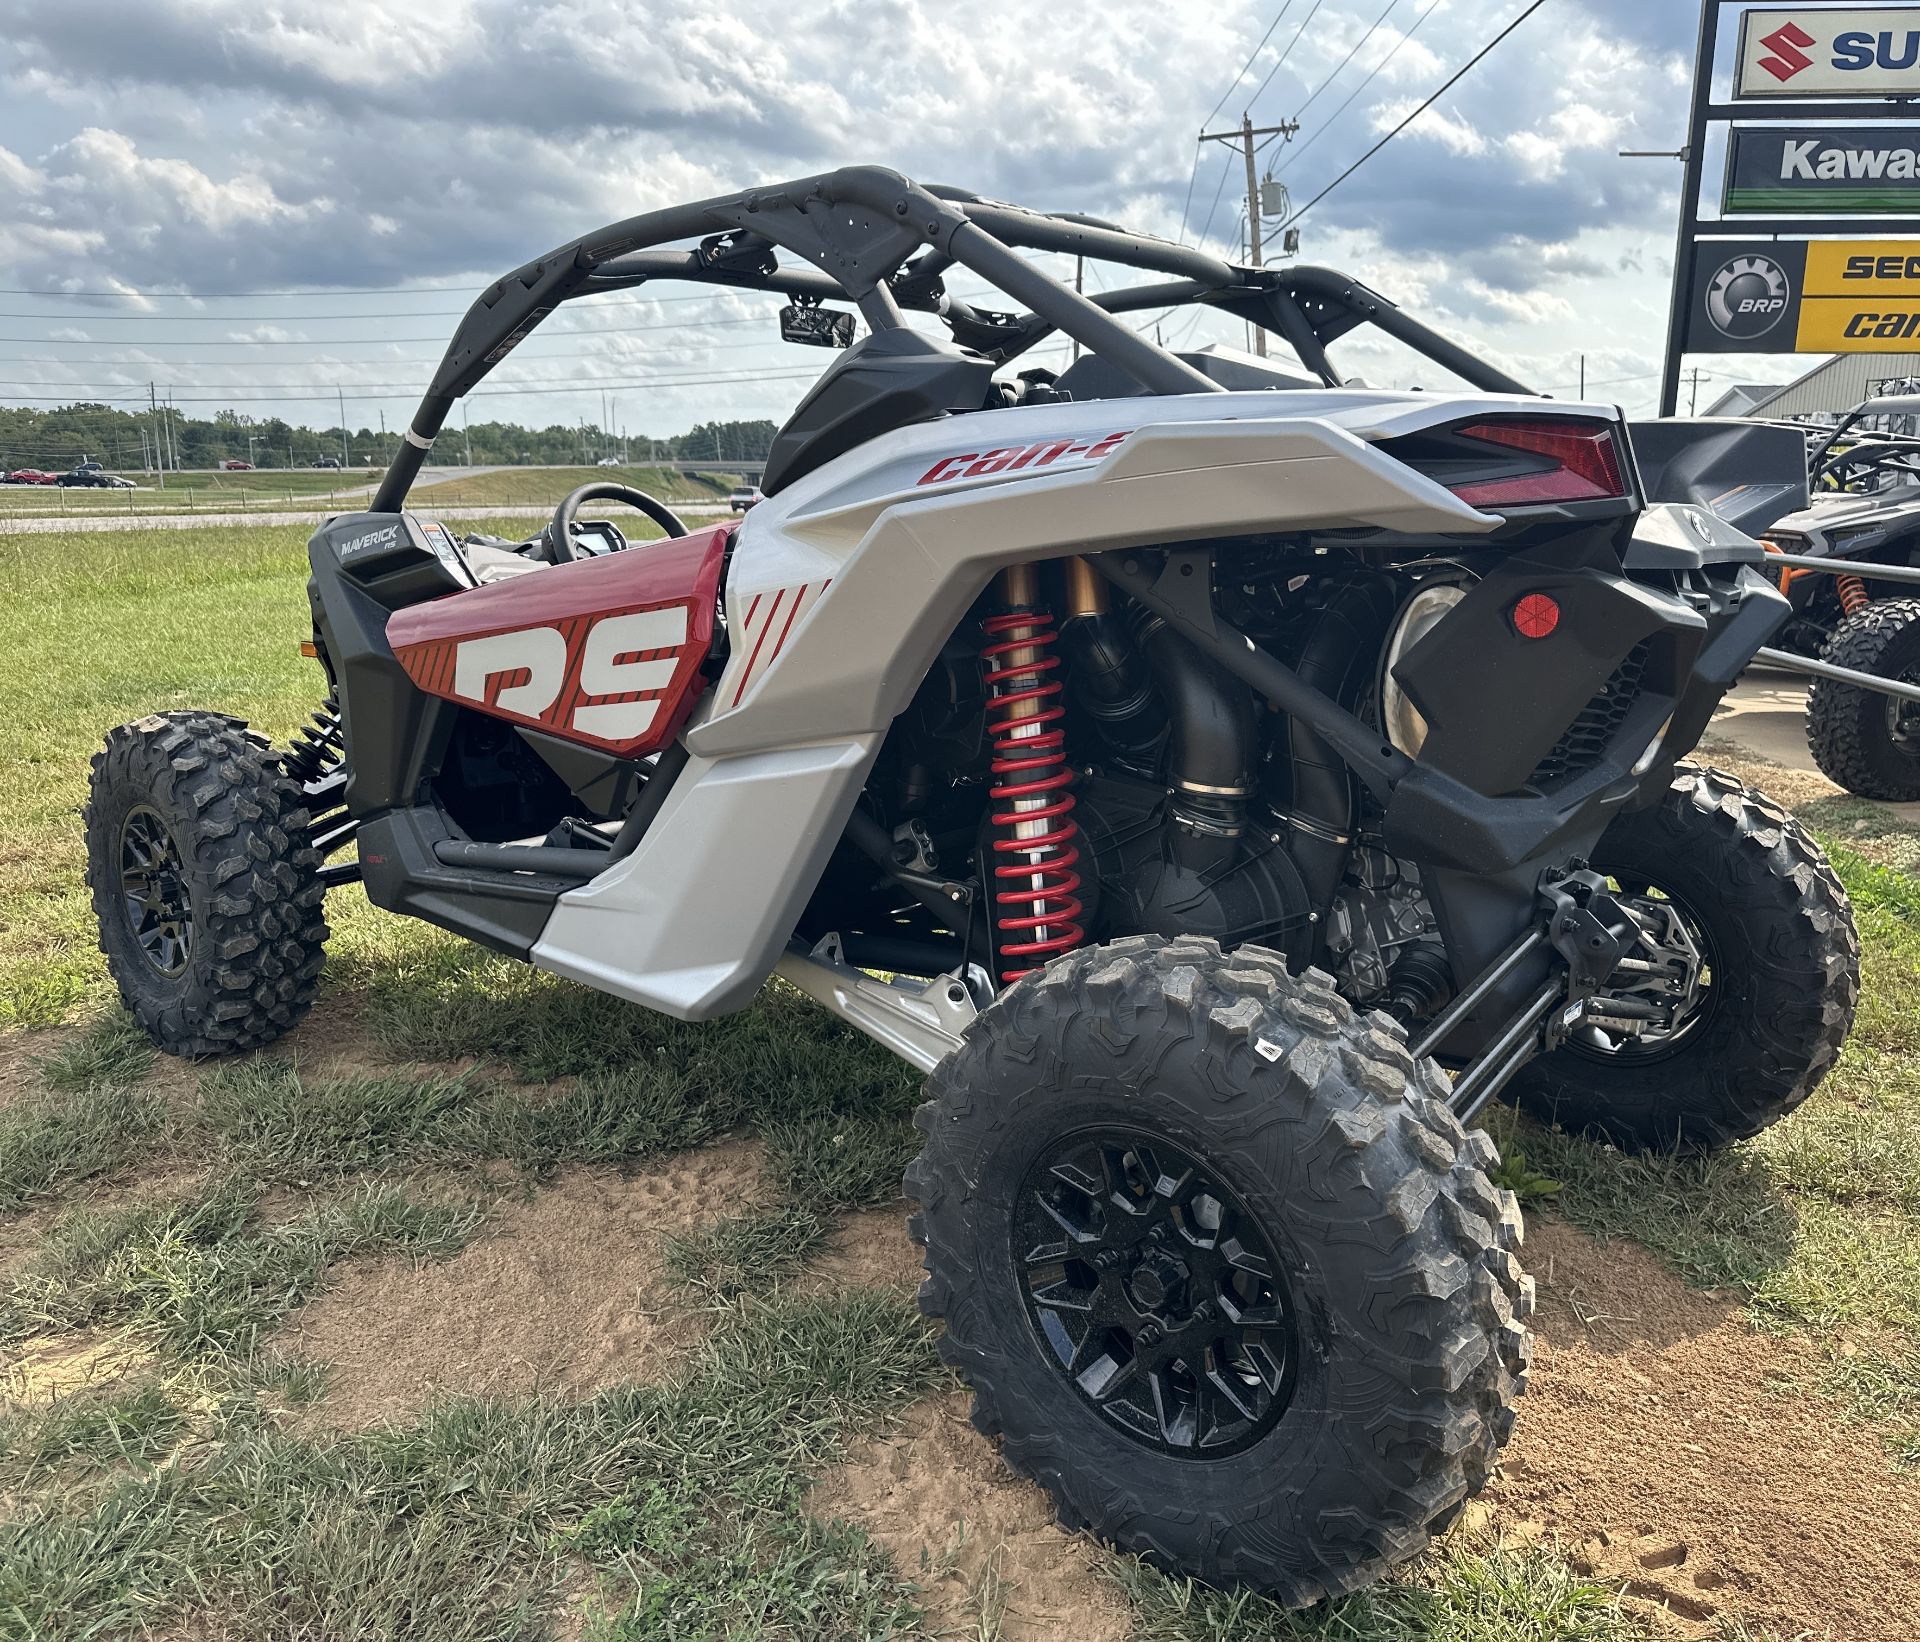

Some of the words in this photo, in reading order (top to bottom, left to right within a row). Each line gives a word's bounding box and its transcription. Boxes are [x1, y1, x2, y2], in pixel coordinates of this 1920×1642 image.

[1831, 31, 1920, 71] SU
[1737, 298, 1784, 313] BRP
[341, 525, 399, 556] MAVERICK
[384, 540, 397, 550] RS
[454, 605, 688, 741] RS
